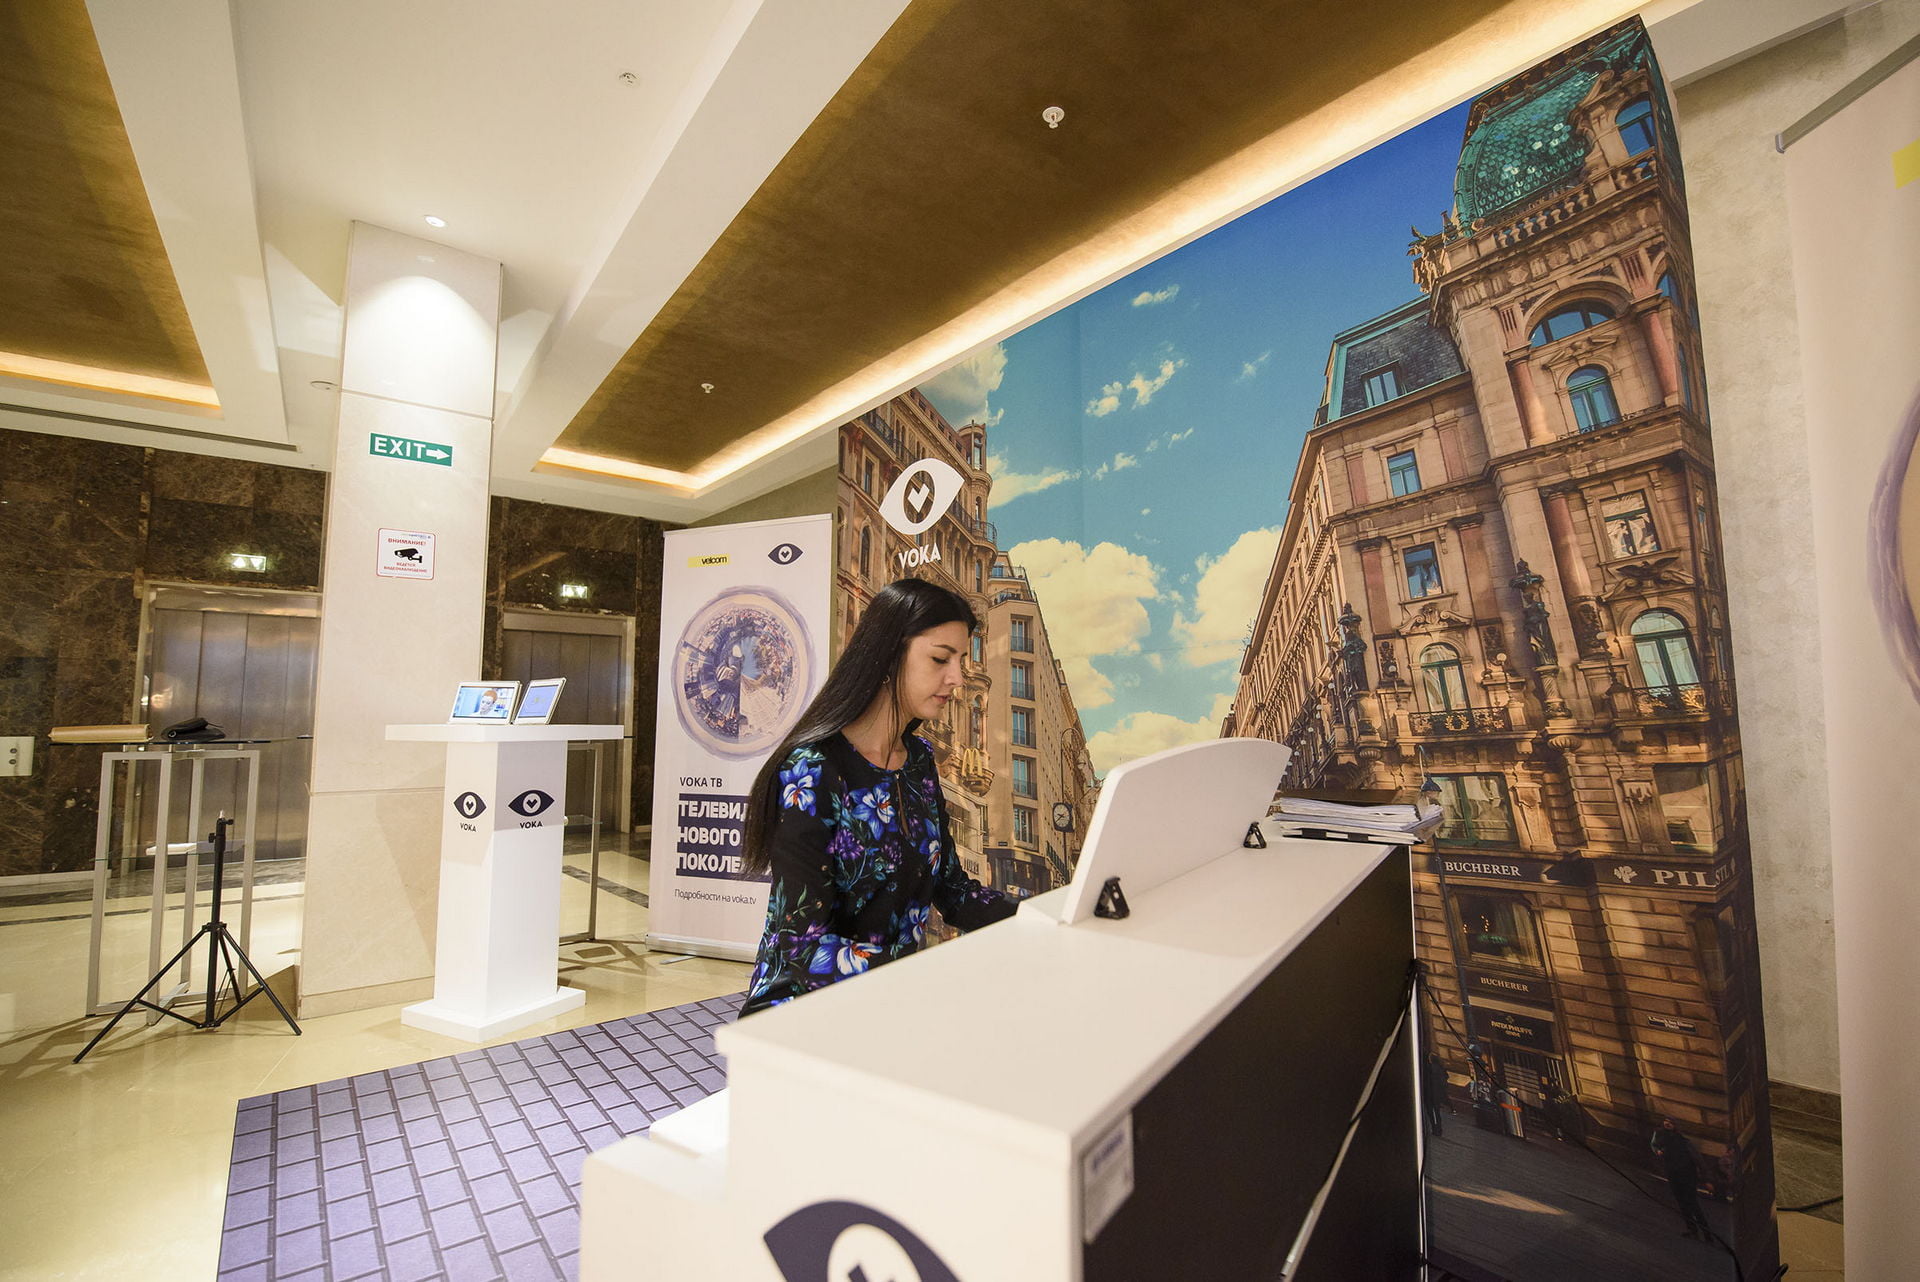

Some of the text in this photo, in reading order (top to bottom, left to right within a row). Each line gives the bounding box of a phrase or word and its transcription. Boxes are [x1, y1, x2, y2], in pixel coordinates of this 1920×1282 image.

[374, 436, 427, 459] EXIT
[387, 537, 426, 546] ВНИМАНИЕ!
[701, 556, 728, 565] velcom
[898, 542, 941, 569] VOKA
[679, 776, 723, 788] VOKA ТВ
[460, 823, 476, 832] VOKA
[519, 820, 543, 829] VOKA
[678, 826, 741, 846] НОВОГО
[678, 853, 746, 874] ПОКОЛЕ
[1444, 861, 1521, 876] BUCHERER
[674, 888, 721, 901] Подробности
[731, 895, 757, 904] voka.tv
[1480, 976, 1529, 992] BUCHERER
